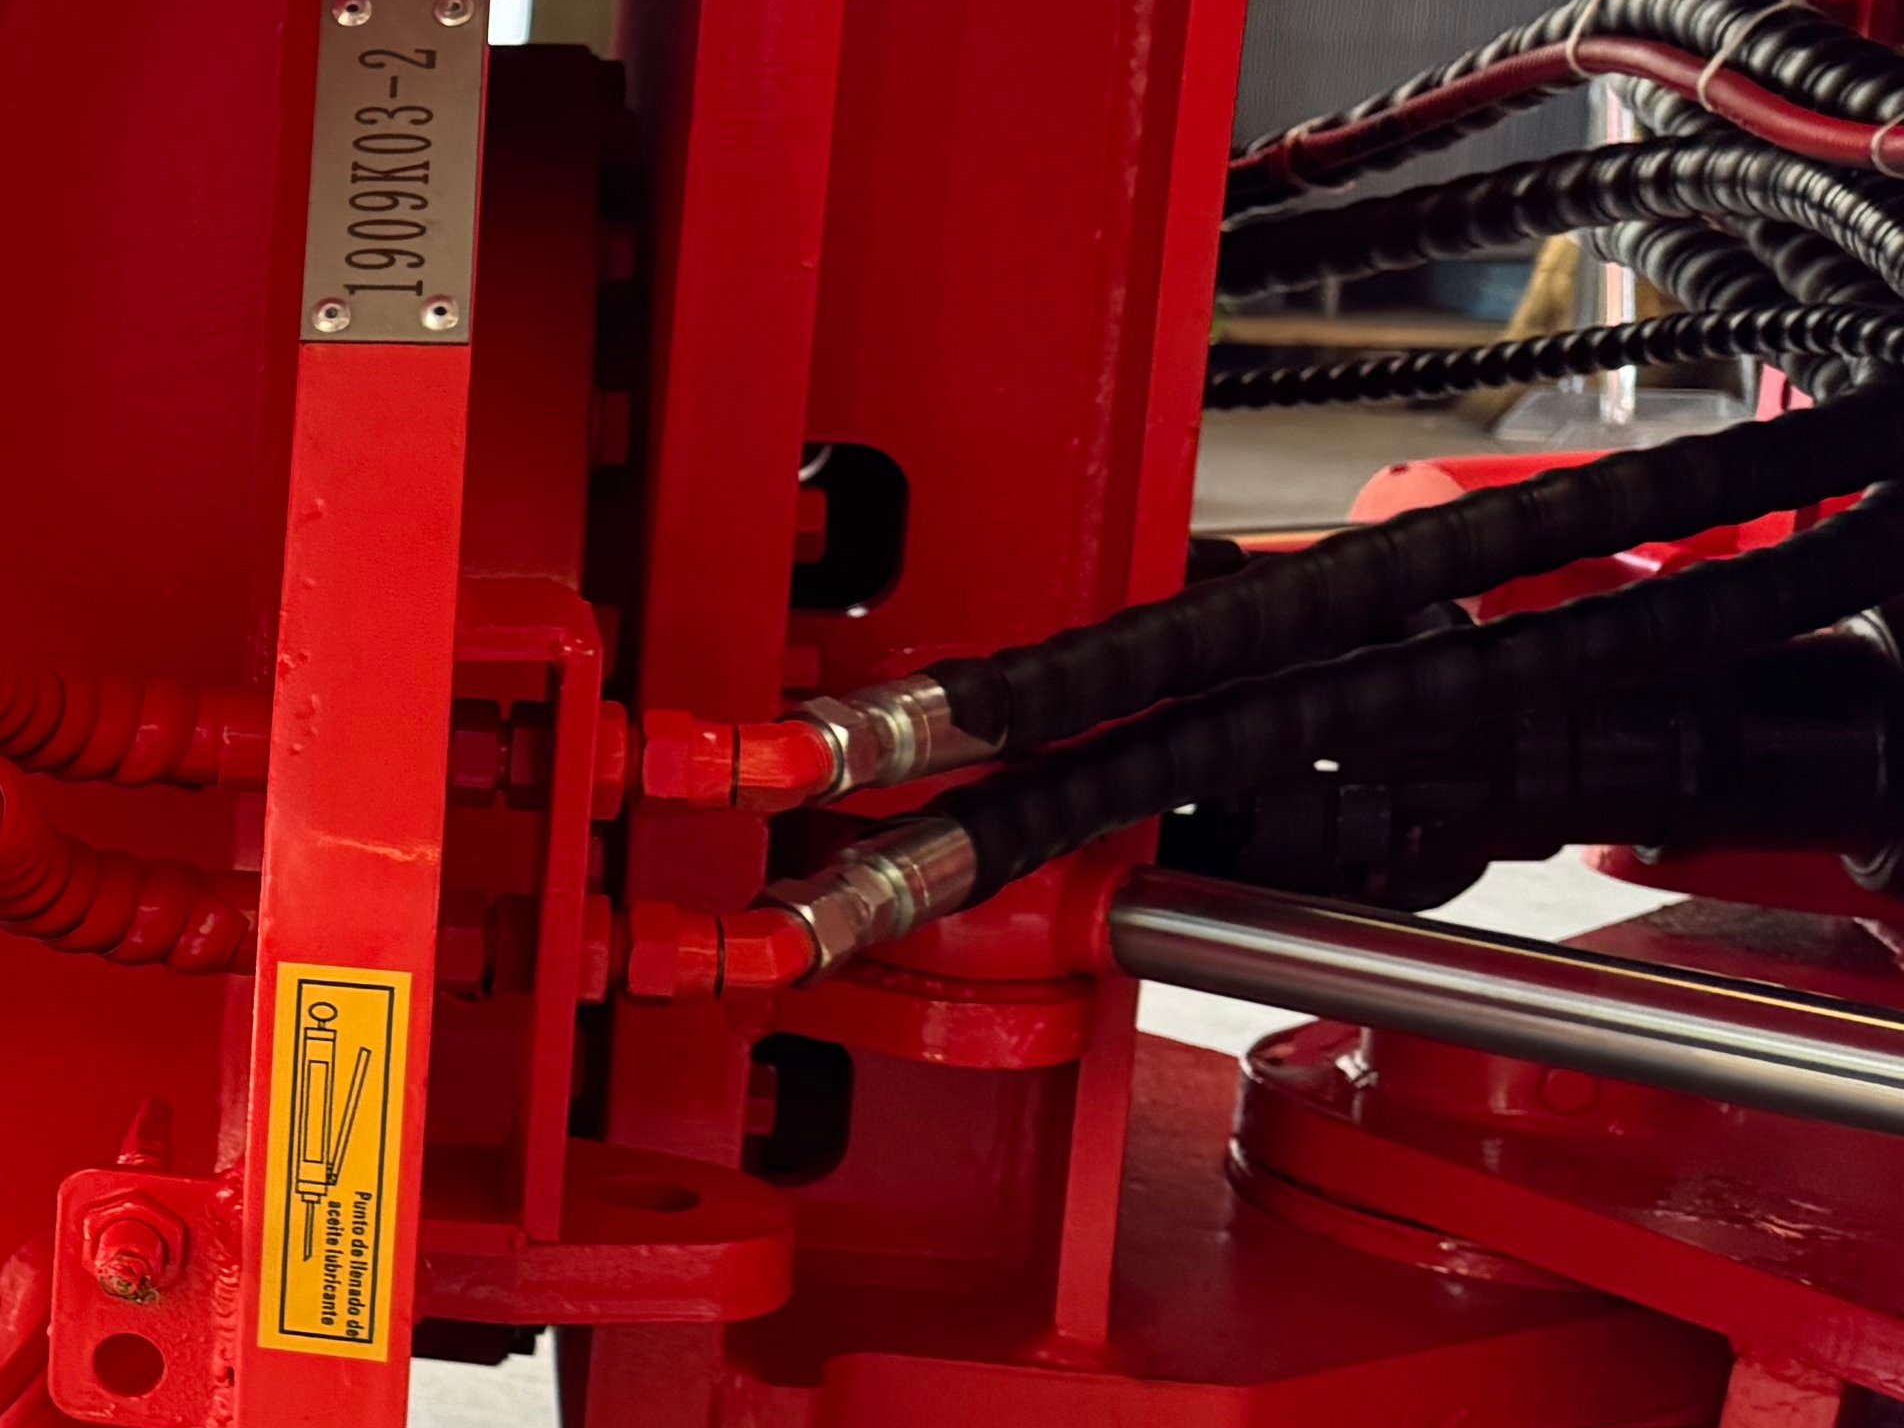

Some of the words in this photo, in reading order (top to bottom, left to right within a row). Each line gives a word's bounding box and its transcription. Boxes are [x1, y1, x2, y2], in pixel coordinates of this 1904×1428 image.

[344, 48, 437, 296] 1909K03-2
[325, 1200, 345, 1246] aceite
[351, 1191, 372, 1235] Punto
[350, 1239, 369, 1257] de
[321, 1249, 344, 1325] lubricante
[347, 1260, 368, 1316] llenado
[346, 1319, 365, 1337] de
